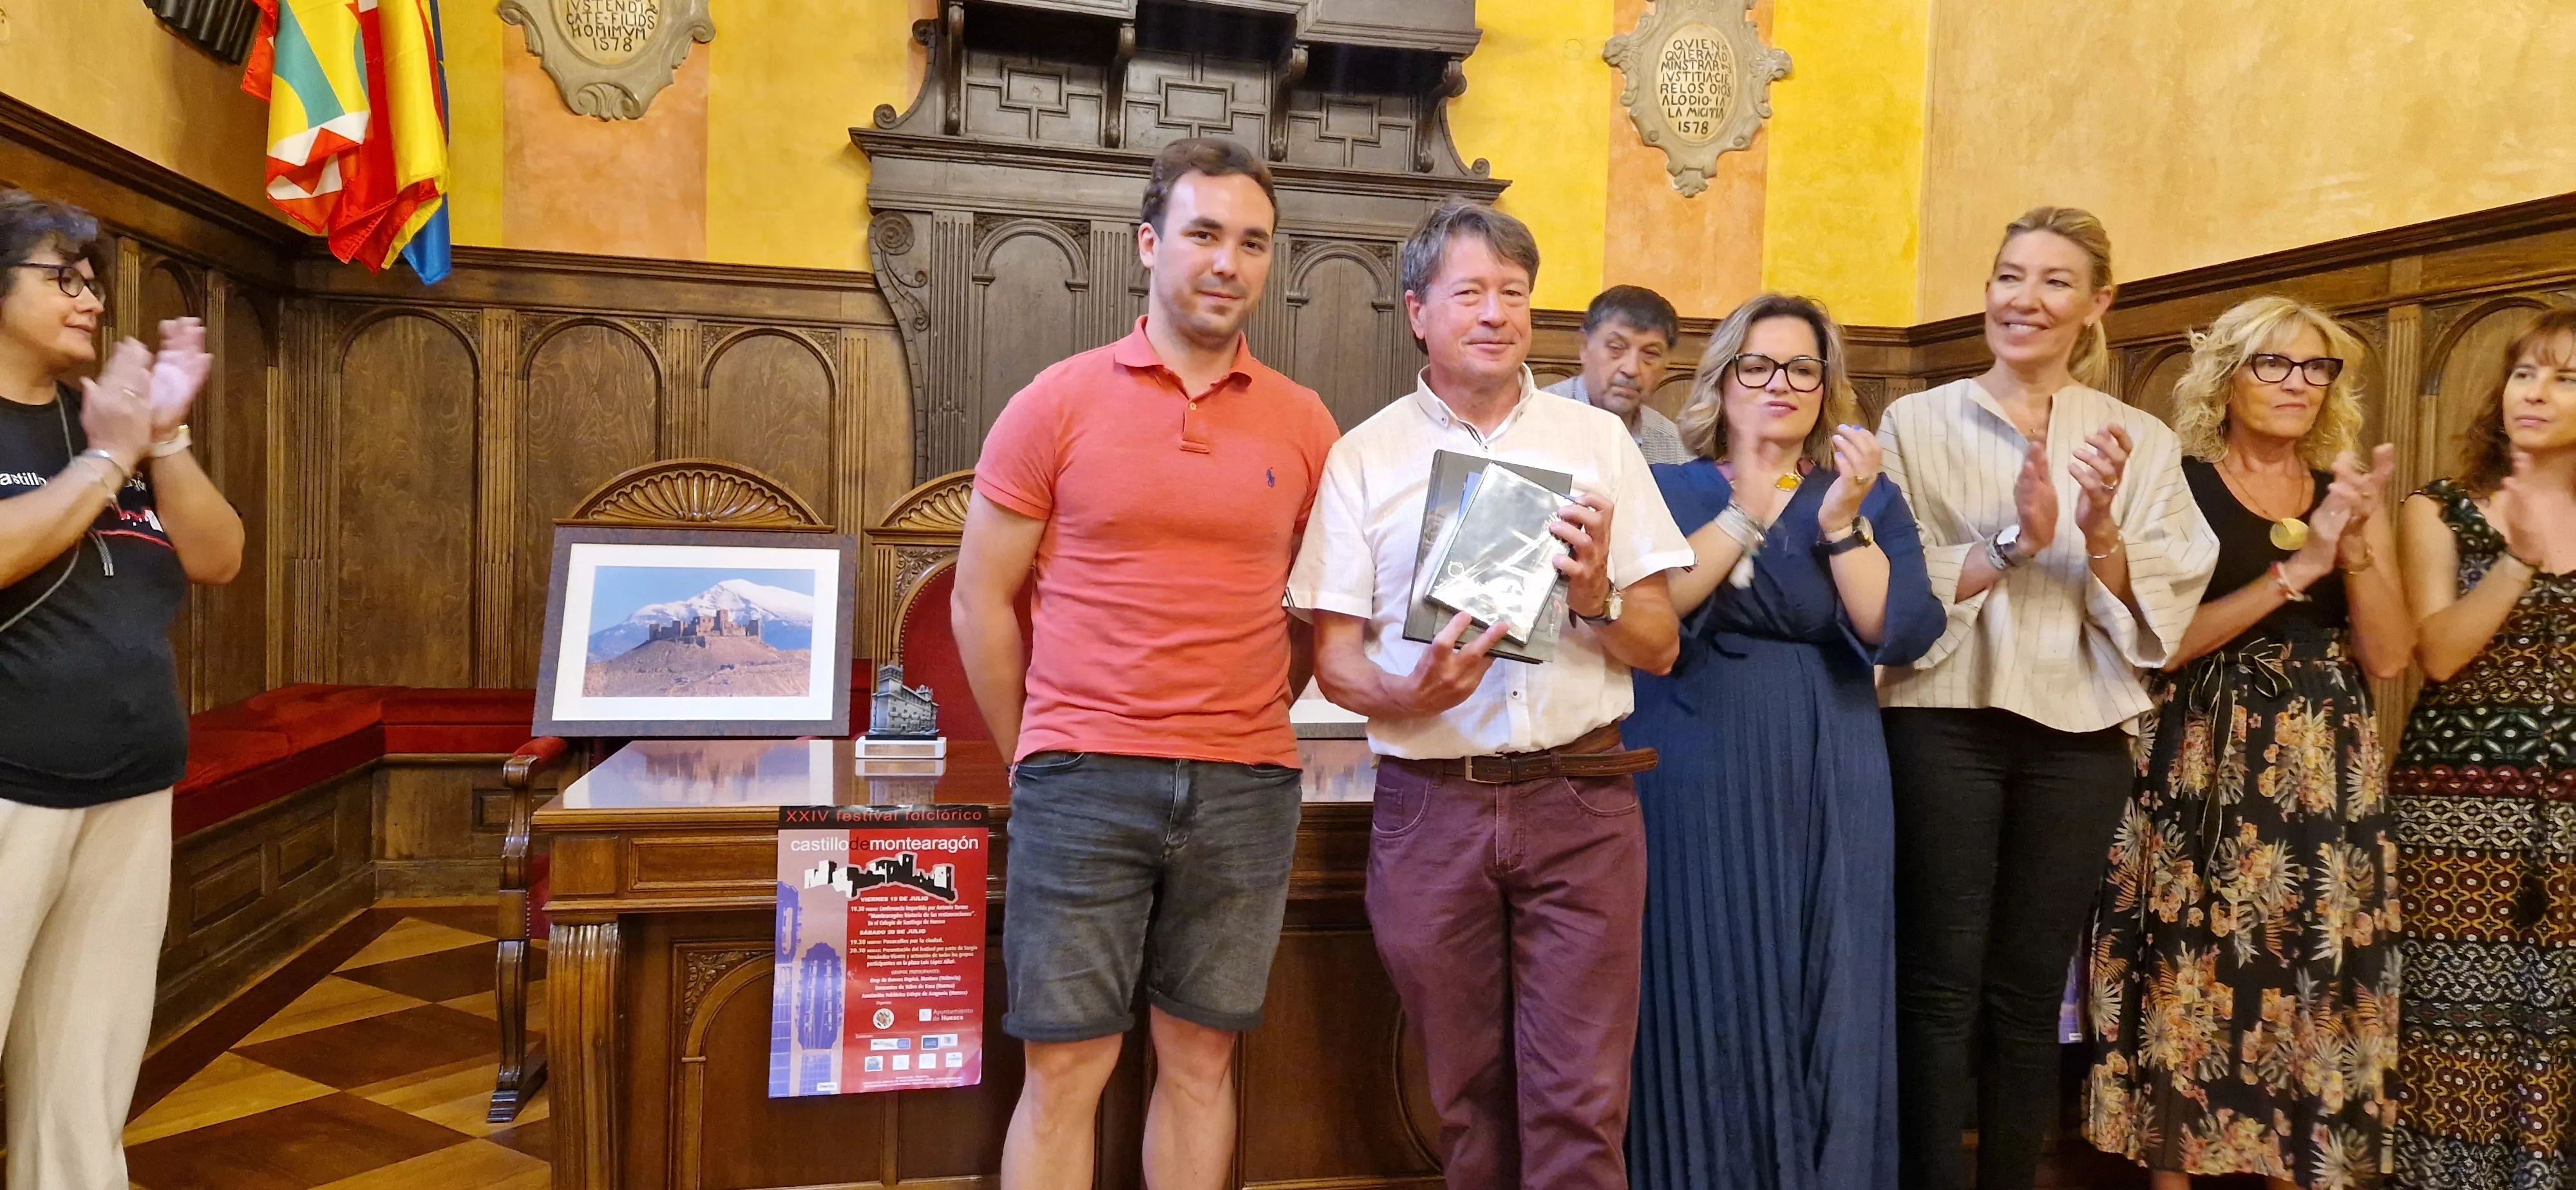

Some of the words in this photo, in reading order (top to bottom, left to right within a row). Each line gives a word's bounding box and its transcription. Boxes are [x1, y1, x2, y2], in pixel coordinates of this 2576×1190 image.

[592, 37, 632, 52] 1578
[1660, 82, 1705, 95] RELOS
[1668, 106, 1683, 118] LA
[1678, 120, 1709, 135] 1578
[786, 810, 829, 822] XXIV
[836, 809, 898, 822] festival
[905, 809, 982, 821] folclórico
